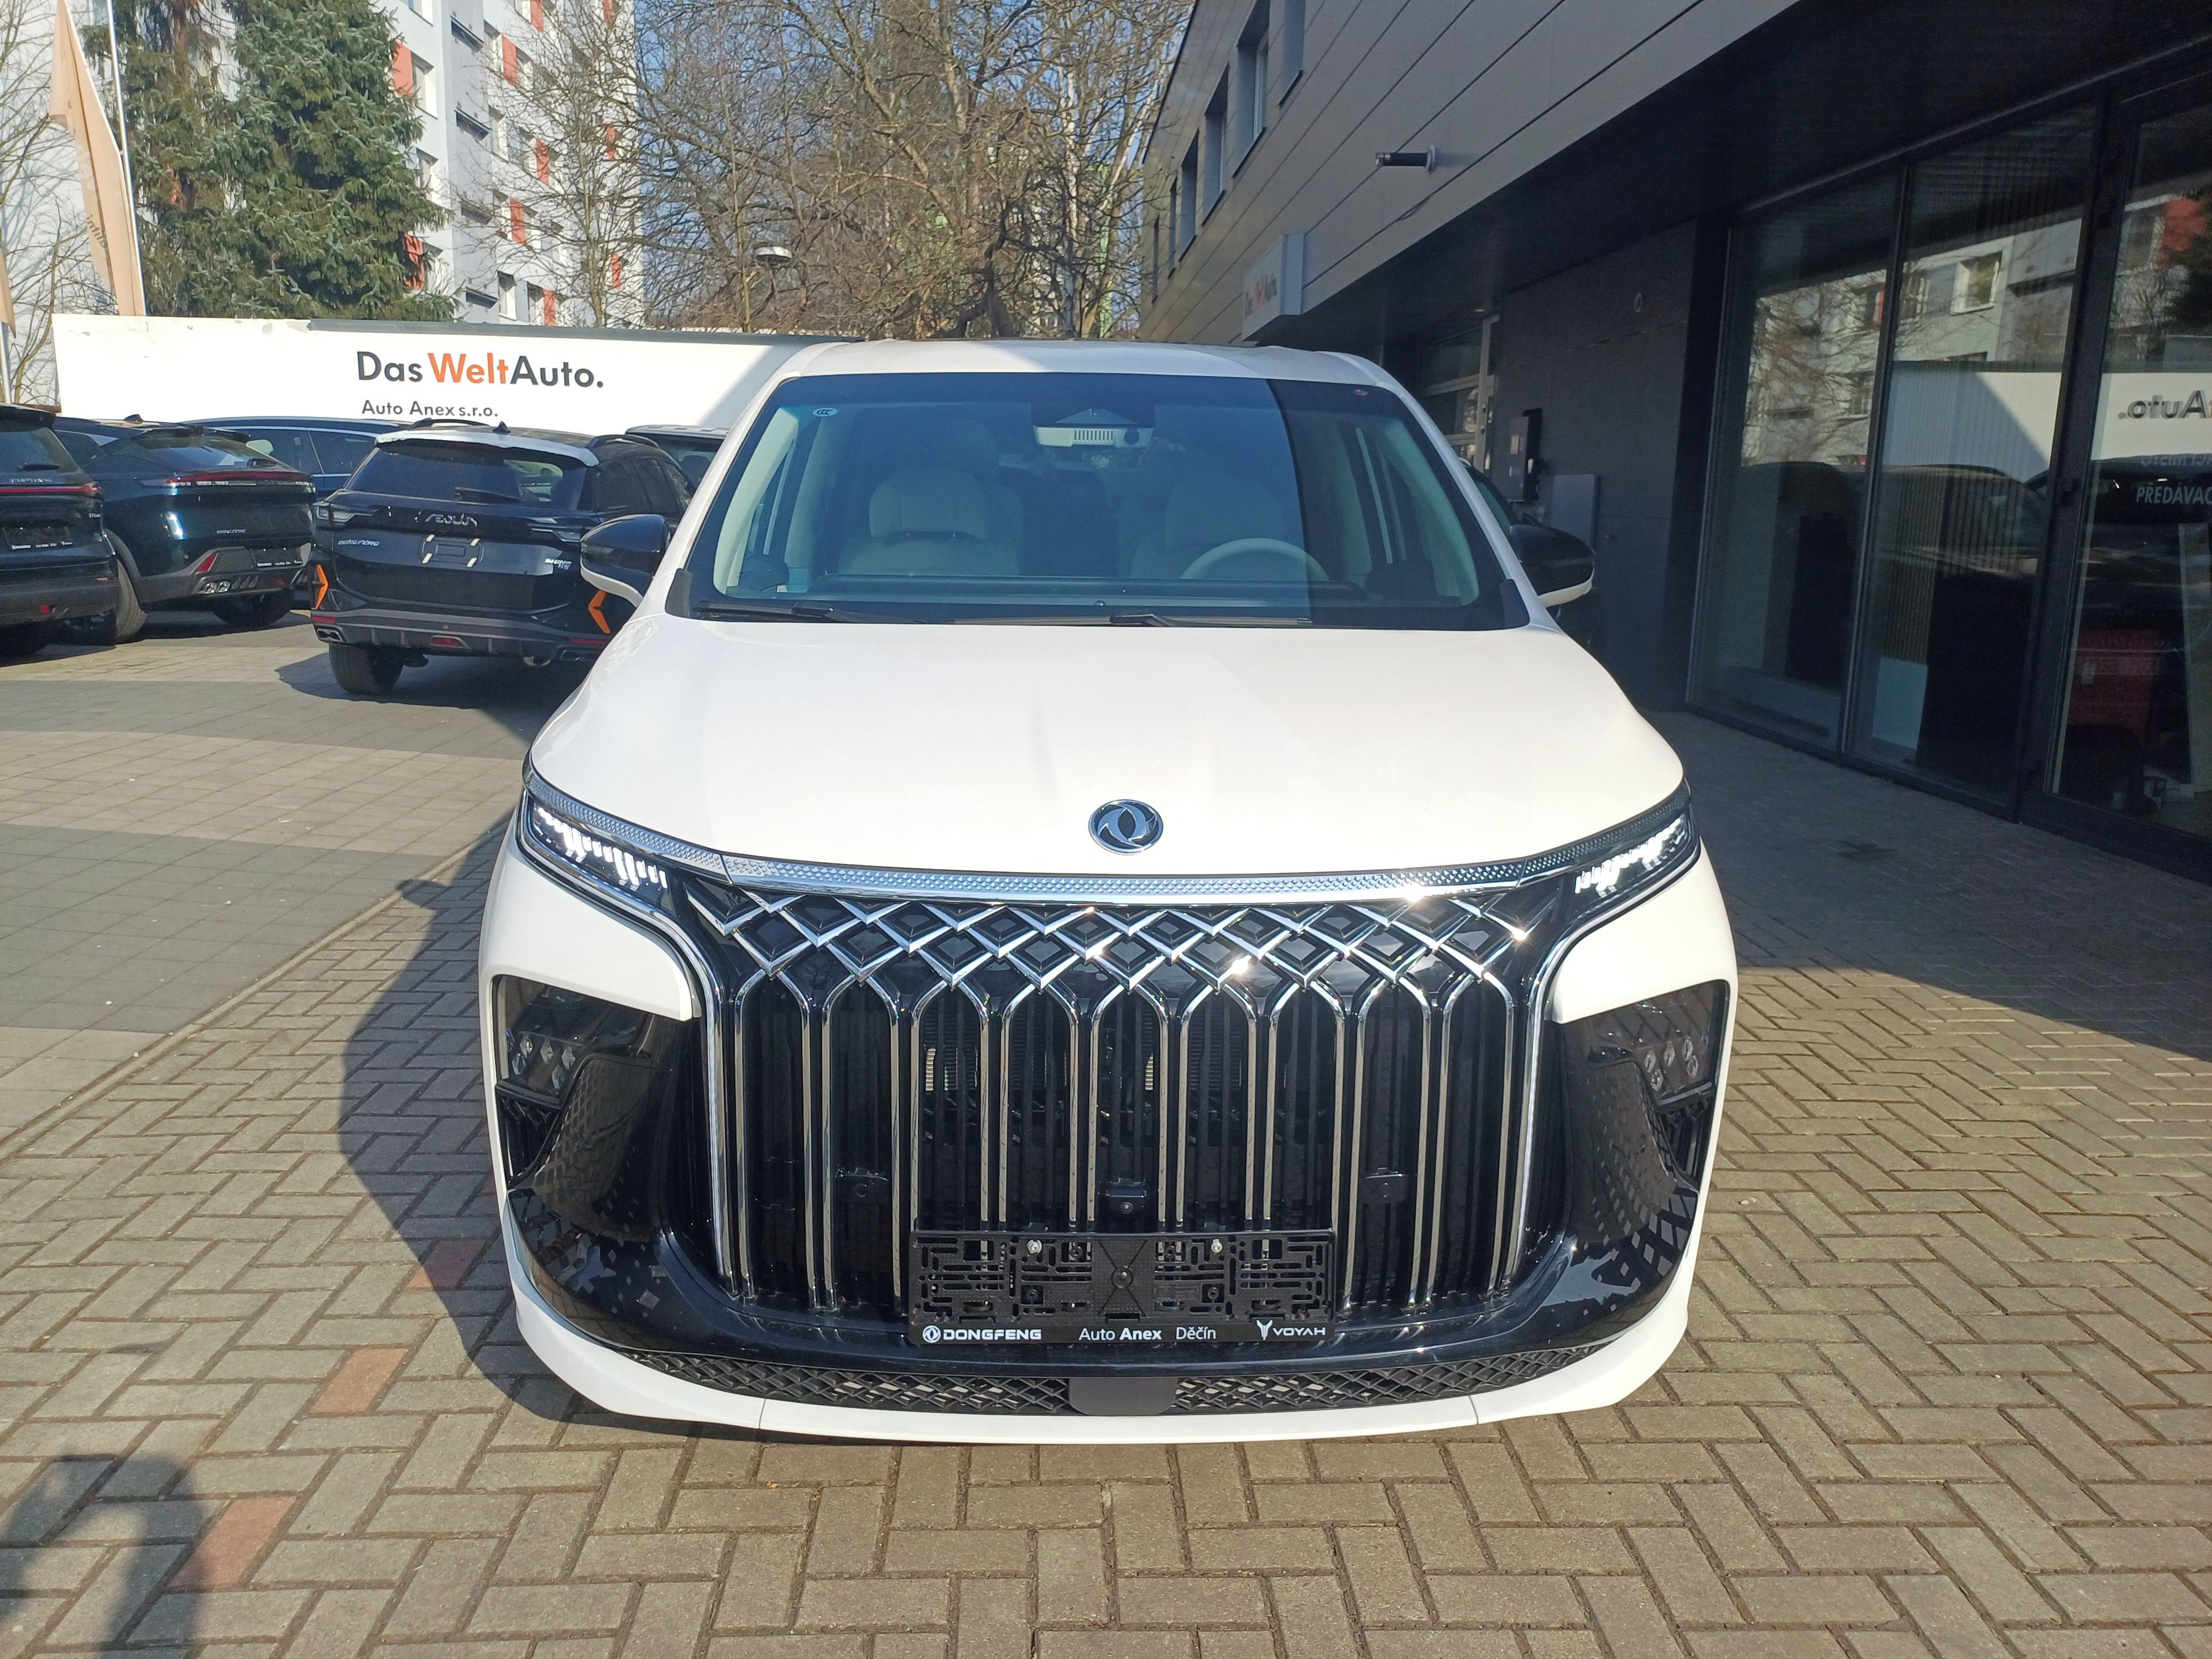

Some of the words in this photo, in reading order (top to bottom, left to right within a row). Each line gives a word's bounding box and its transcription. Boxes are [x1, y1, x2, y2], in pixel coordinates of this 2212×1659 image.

[357, 351, 423, 383] Das
[427, 352, 604, 388] WeltAuto.
[362, 399, 403, 415] Auto
[409, 400, 455, 416] Anex
[458, 406, 498, 418] s.r.o.
[943, 1328, 1042, 1340] DONGFENG
[1078, 1328, 1115, 1341] Auto
[1119, 1327, 1162, 1340] Anex
[1176, 1326, 1217, 1340] Děčín
[1272, 1327, 1326, 1337] VOYAH
